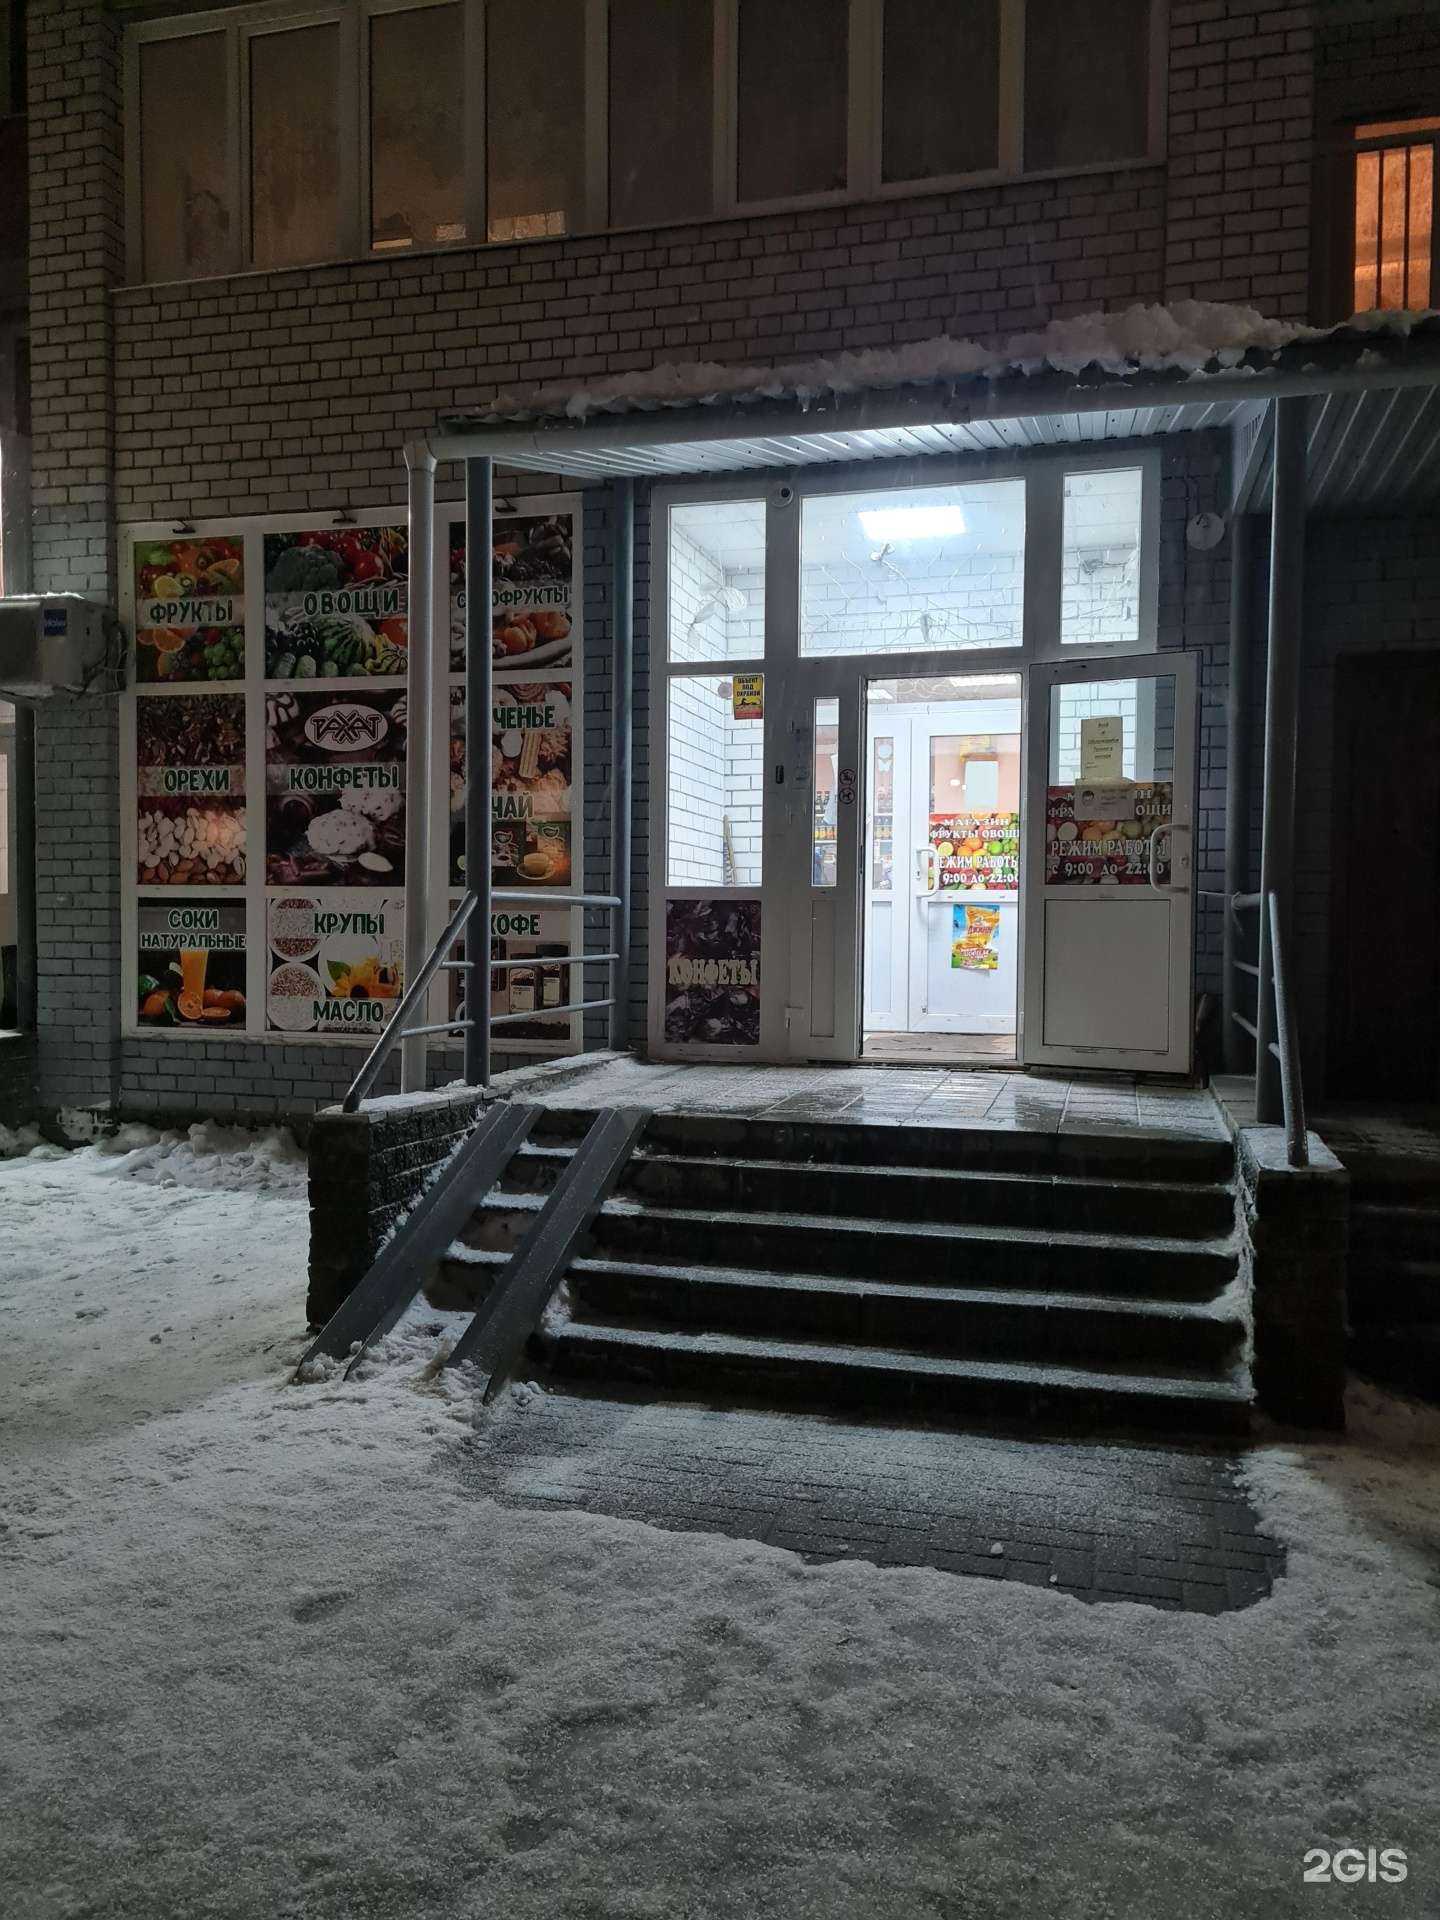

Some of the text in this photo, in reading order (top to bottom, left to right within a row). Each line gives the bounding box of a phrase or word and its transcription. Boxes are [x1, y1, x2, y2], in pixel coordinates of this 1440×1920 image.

[150, 599, 233, 624] ФРУКТЫ
[303, 589, 399, 618] ОВОЩИ
[311, 710, 382, 743] РАХАТ
[164, 769, 230, 792] ОРЕХИ
[289, 766, 398, 791] КОНФЕТЫ
[491, 792, 534, 818] ЧАЙ
[930, 827, 1019, 839] ФРУКТЫ ОВОЩ
[1051, 840, 1102, 857] РЕЖИМ
[940, 855, 973, 869] ЕЖИМ
[1065, 862, 1094, 877] 9:00
[942, 873, 967, 885] 9:00
[169, 910, 218, 928] СОКИ
[313, 912, 385, 935] КРУПЫ
[141, 933, 246, 949] НАТУРАЛЬНЫЕ
[668, 958, 758, 985] КОНФЕТЫ
[312, 1000, 384, 1022] МАСЛО
